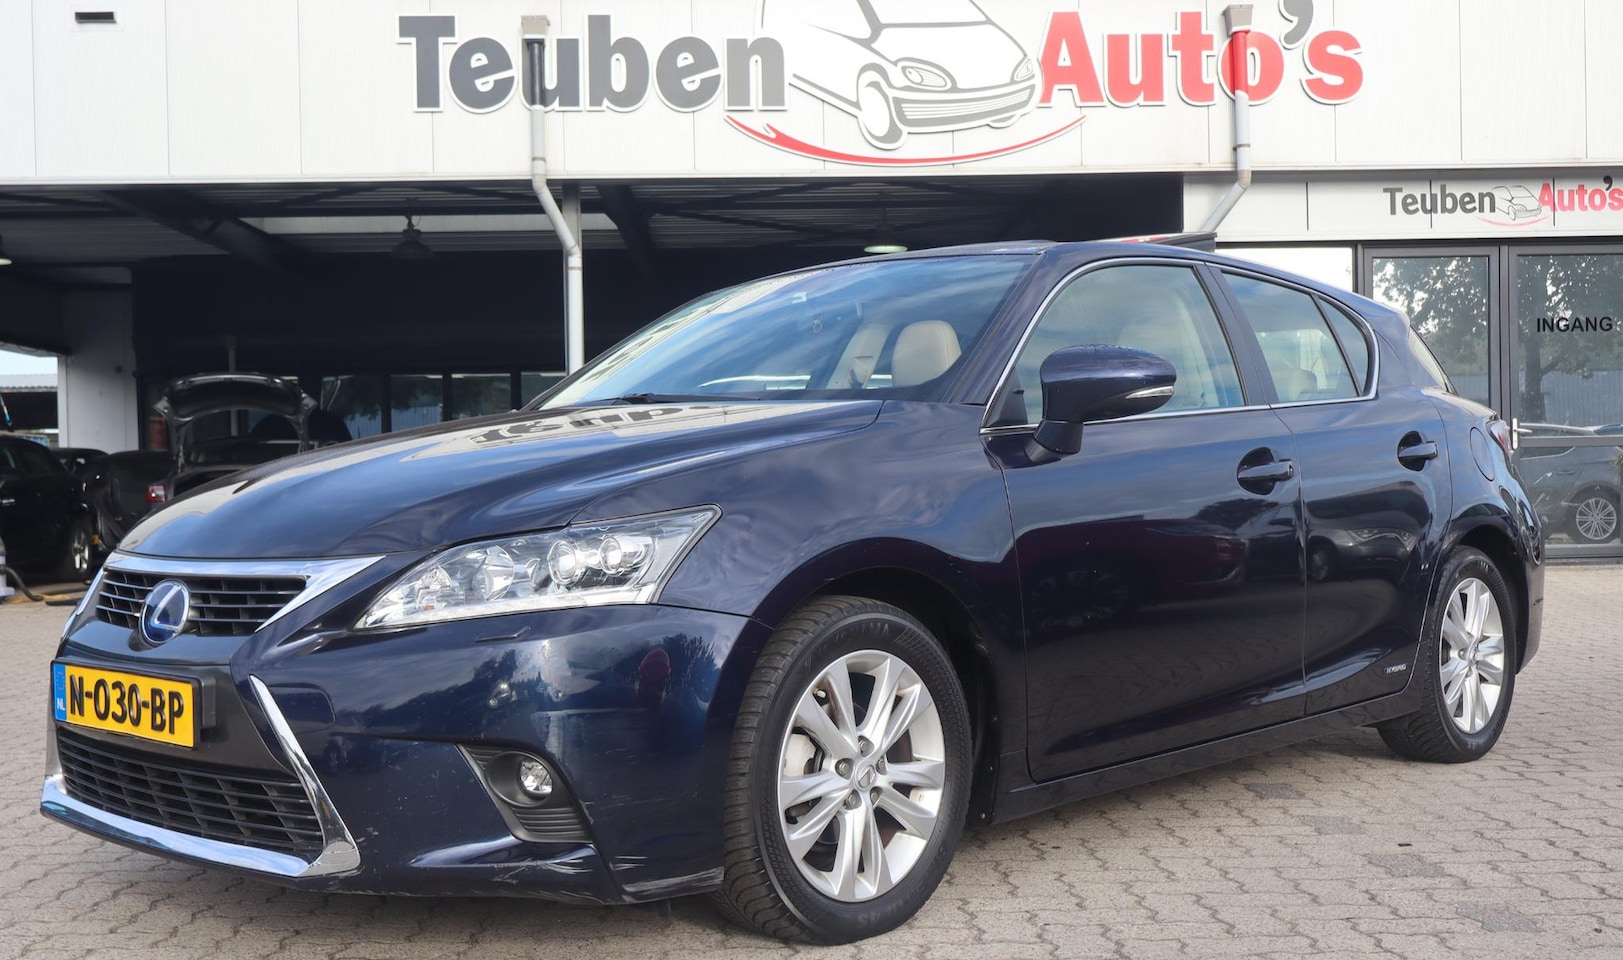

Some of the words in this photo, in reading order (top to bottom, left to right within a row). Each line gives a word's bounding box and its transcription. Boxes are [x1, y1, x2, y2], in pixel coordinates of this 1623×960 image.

[397, 14, 787, 112] Teuben
[1039, 0, 1364, 105] Auto's
[1383, 184, 1496, 215] Teuben
[1538, 176, 1623, 212] Auto's
[1537, 317, 1613, 333] INGANG
[69, 674, 184, 734] N-030-BP
